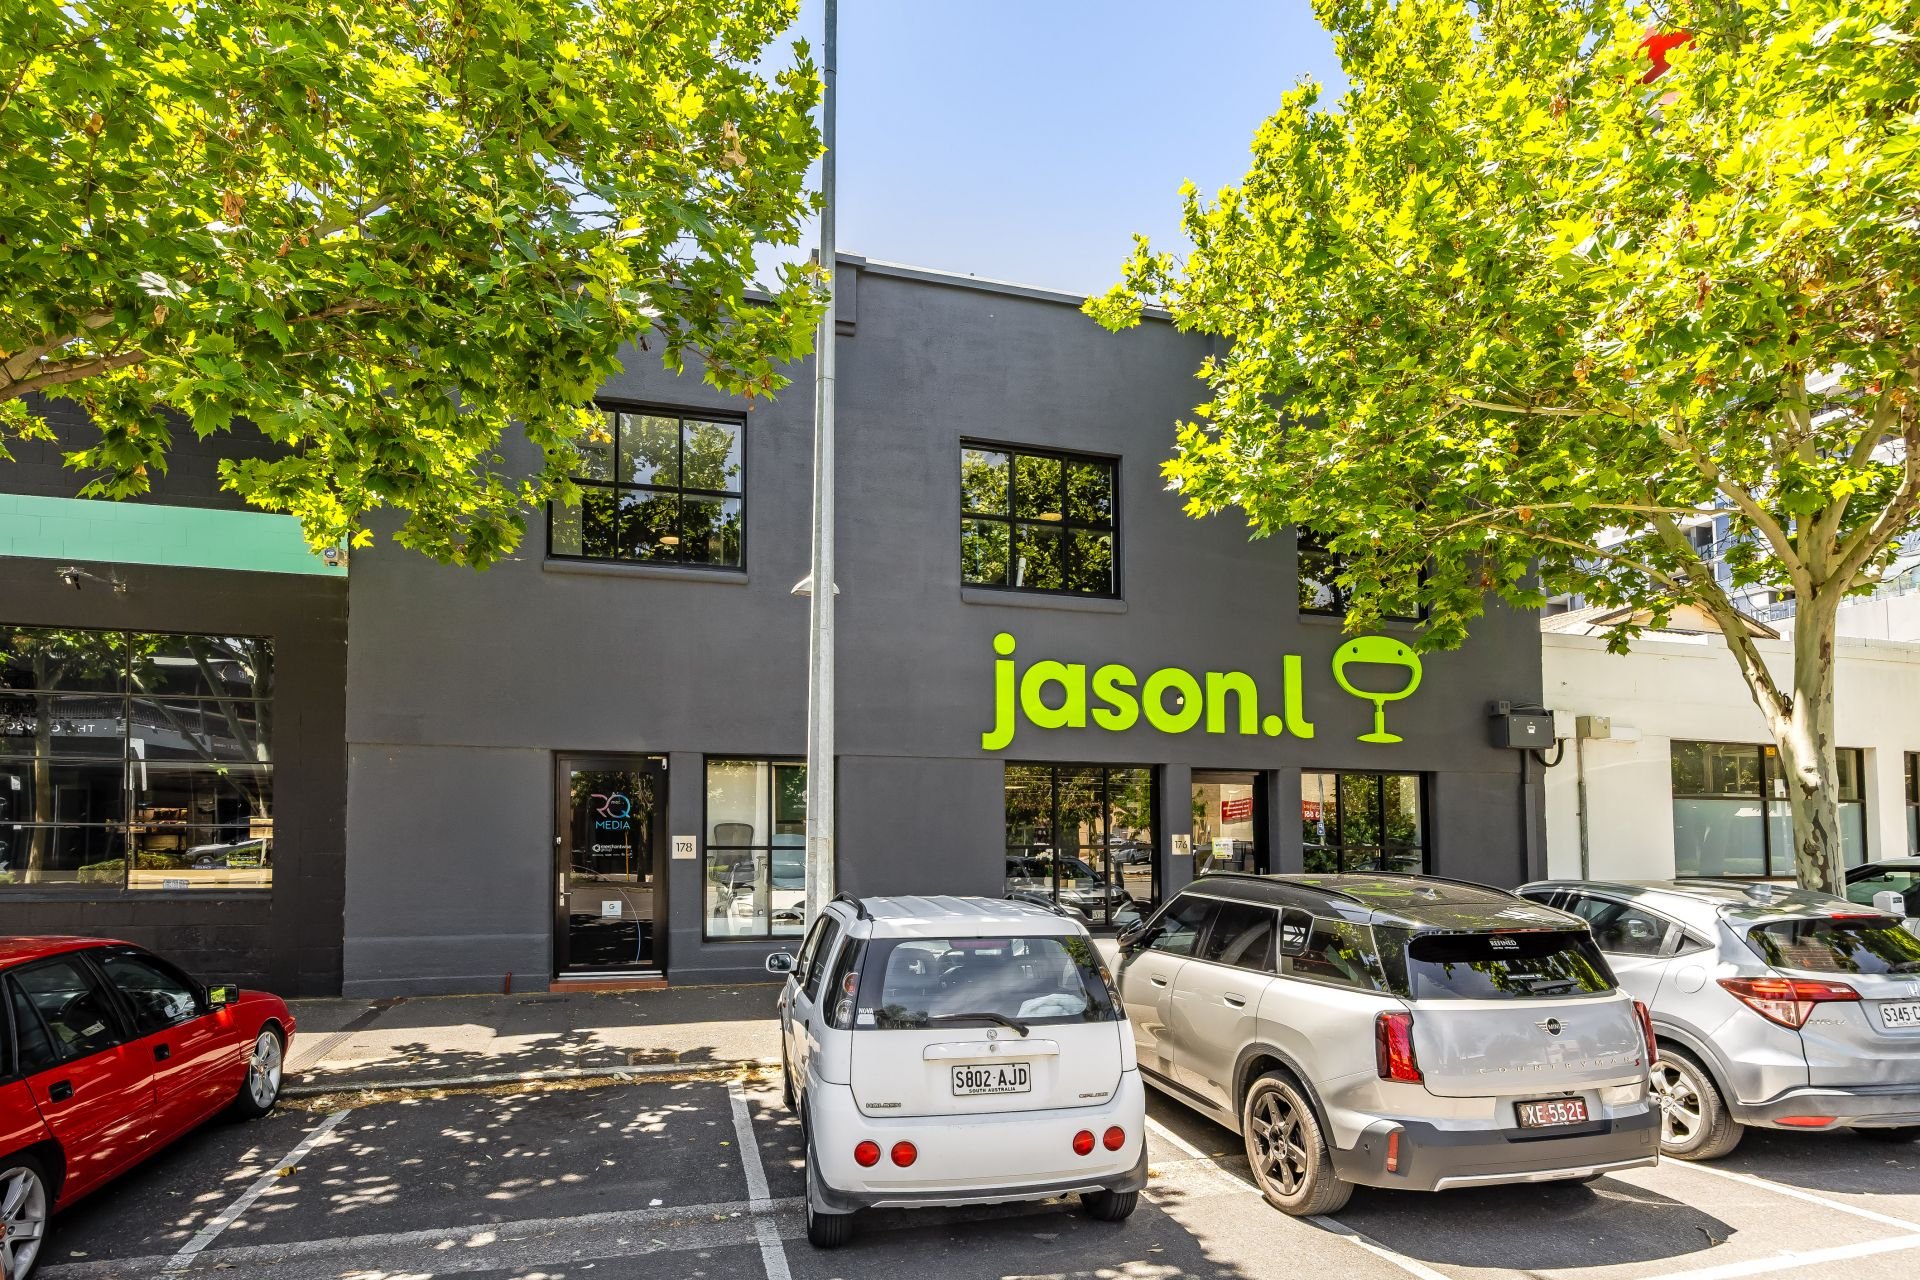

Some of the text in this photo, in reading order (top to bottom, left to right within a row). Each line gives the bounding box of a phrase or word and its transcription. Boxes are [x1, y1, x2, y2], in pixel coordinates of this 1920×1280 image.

[982, 632, 1314, 750] jason.l
[595, 820, 631, 830] MEDIA
[676, 842, 693, 853] 178
[1175, 840, 1188, 849] 176
